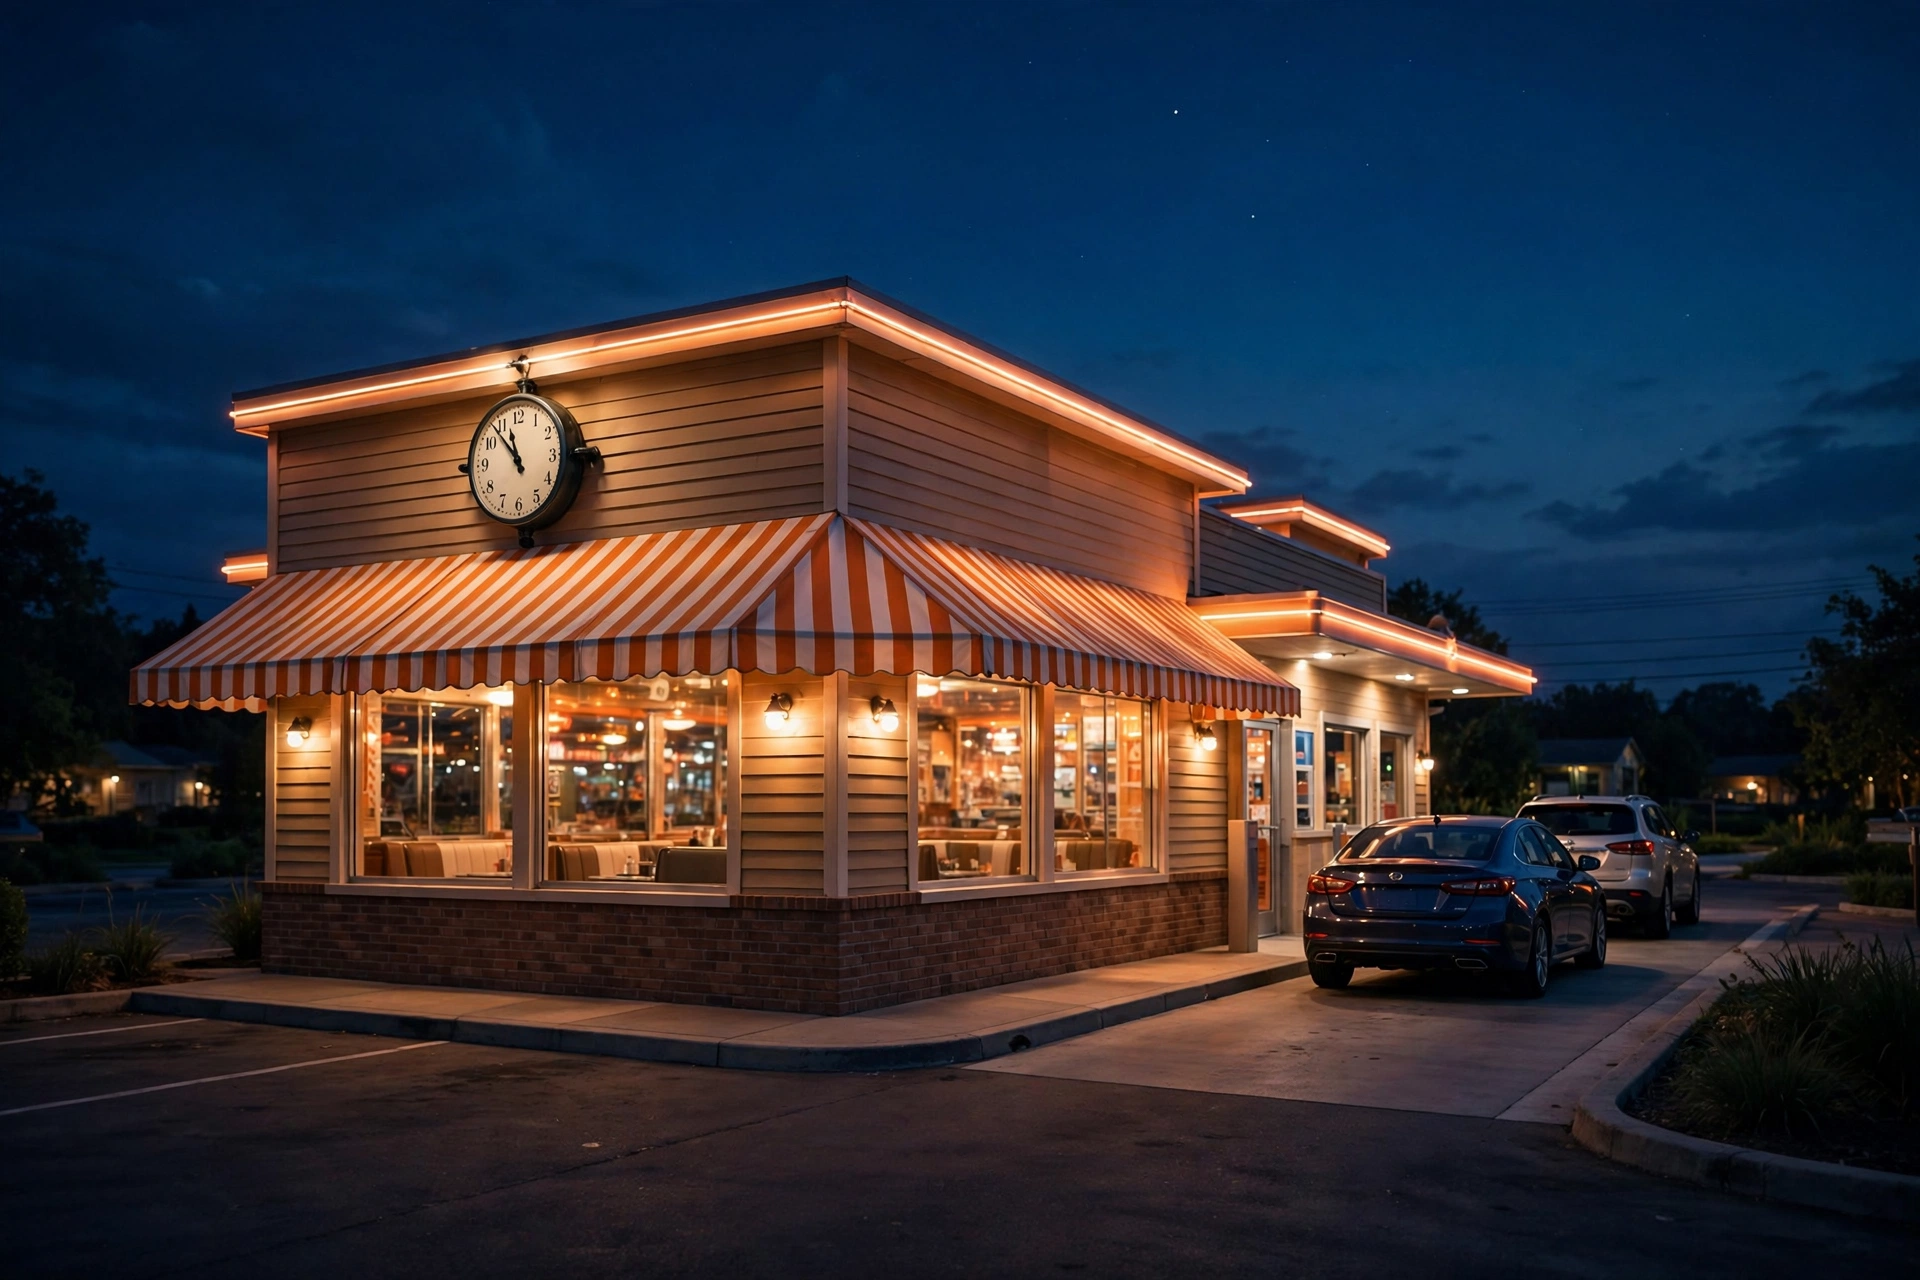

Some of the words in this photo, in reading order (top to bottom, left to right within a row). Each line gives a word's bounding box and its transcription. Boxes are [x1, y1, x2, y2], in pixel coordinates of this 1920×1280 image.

[513, 409, 524, 424] 12
[534, 413, 538, 427] 1
[498, 418, 506, 432] 11
[544, 426, 551, 440] 2
[485, 436, 497, 450] 10
[548, 448, 557, 462] 3
[481, 458, 489, 472] 9
[543, 470, 552, 485] 4
[486, 480, 494, 493] 8
[499, 494, 506, 508] 7
[533, 489, 540, 503] 5
[515, 497, 523, 511] 6
